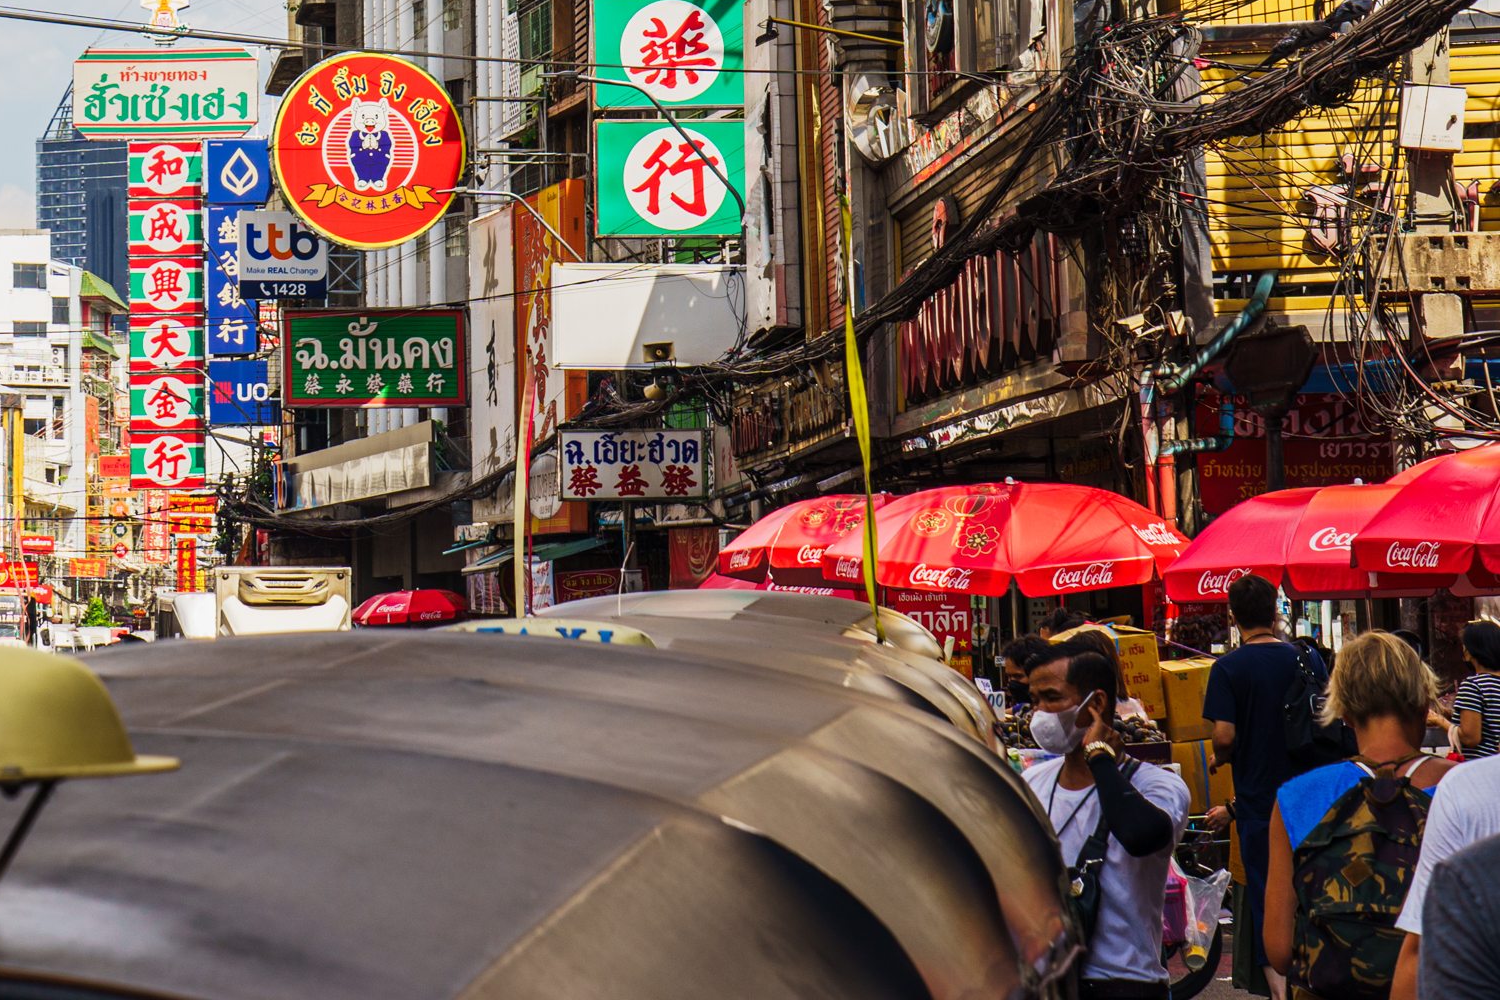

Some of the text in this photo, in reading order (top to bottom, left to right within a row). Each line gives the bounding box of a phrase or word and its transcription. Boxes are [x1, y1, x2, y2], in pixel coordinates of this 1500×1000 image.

[119, 66, 207, 82] ห้างขายทอง
[246, 223, 319, 261] ttb
[246, 266, 318, 277] Make REAL Change
[272, 283, 306, 296] 1428
[147, 150, 186, 480] 和成興大金行
[236, 383, 268, 402] UO
[1320, 441, 1394, 459] เยาวรา
[1203, 459, 1262, 479] จำหน่าย
[567, 464, 698, 497] 蔡益發
[1135, 522, 1181, 546] Coca-Cola
[729, 549, 750, 569] Coca-Cola
[797, 544, 835, 564] Coca-
[1386, 541, 1442, 568] Coca-Cola
[836, 556, 861, 579] Coca-Cola
[909, 563, 974, 590] Coca-Cola
[1052, 561, 1114, 590] Coca-Cola
[1197, 567, 1253, 595] Coca-C
[376, 603, 406, 614] Coca-Cola
[419, 610, 442, 620] Coca-Cola
